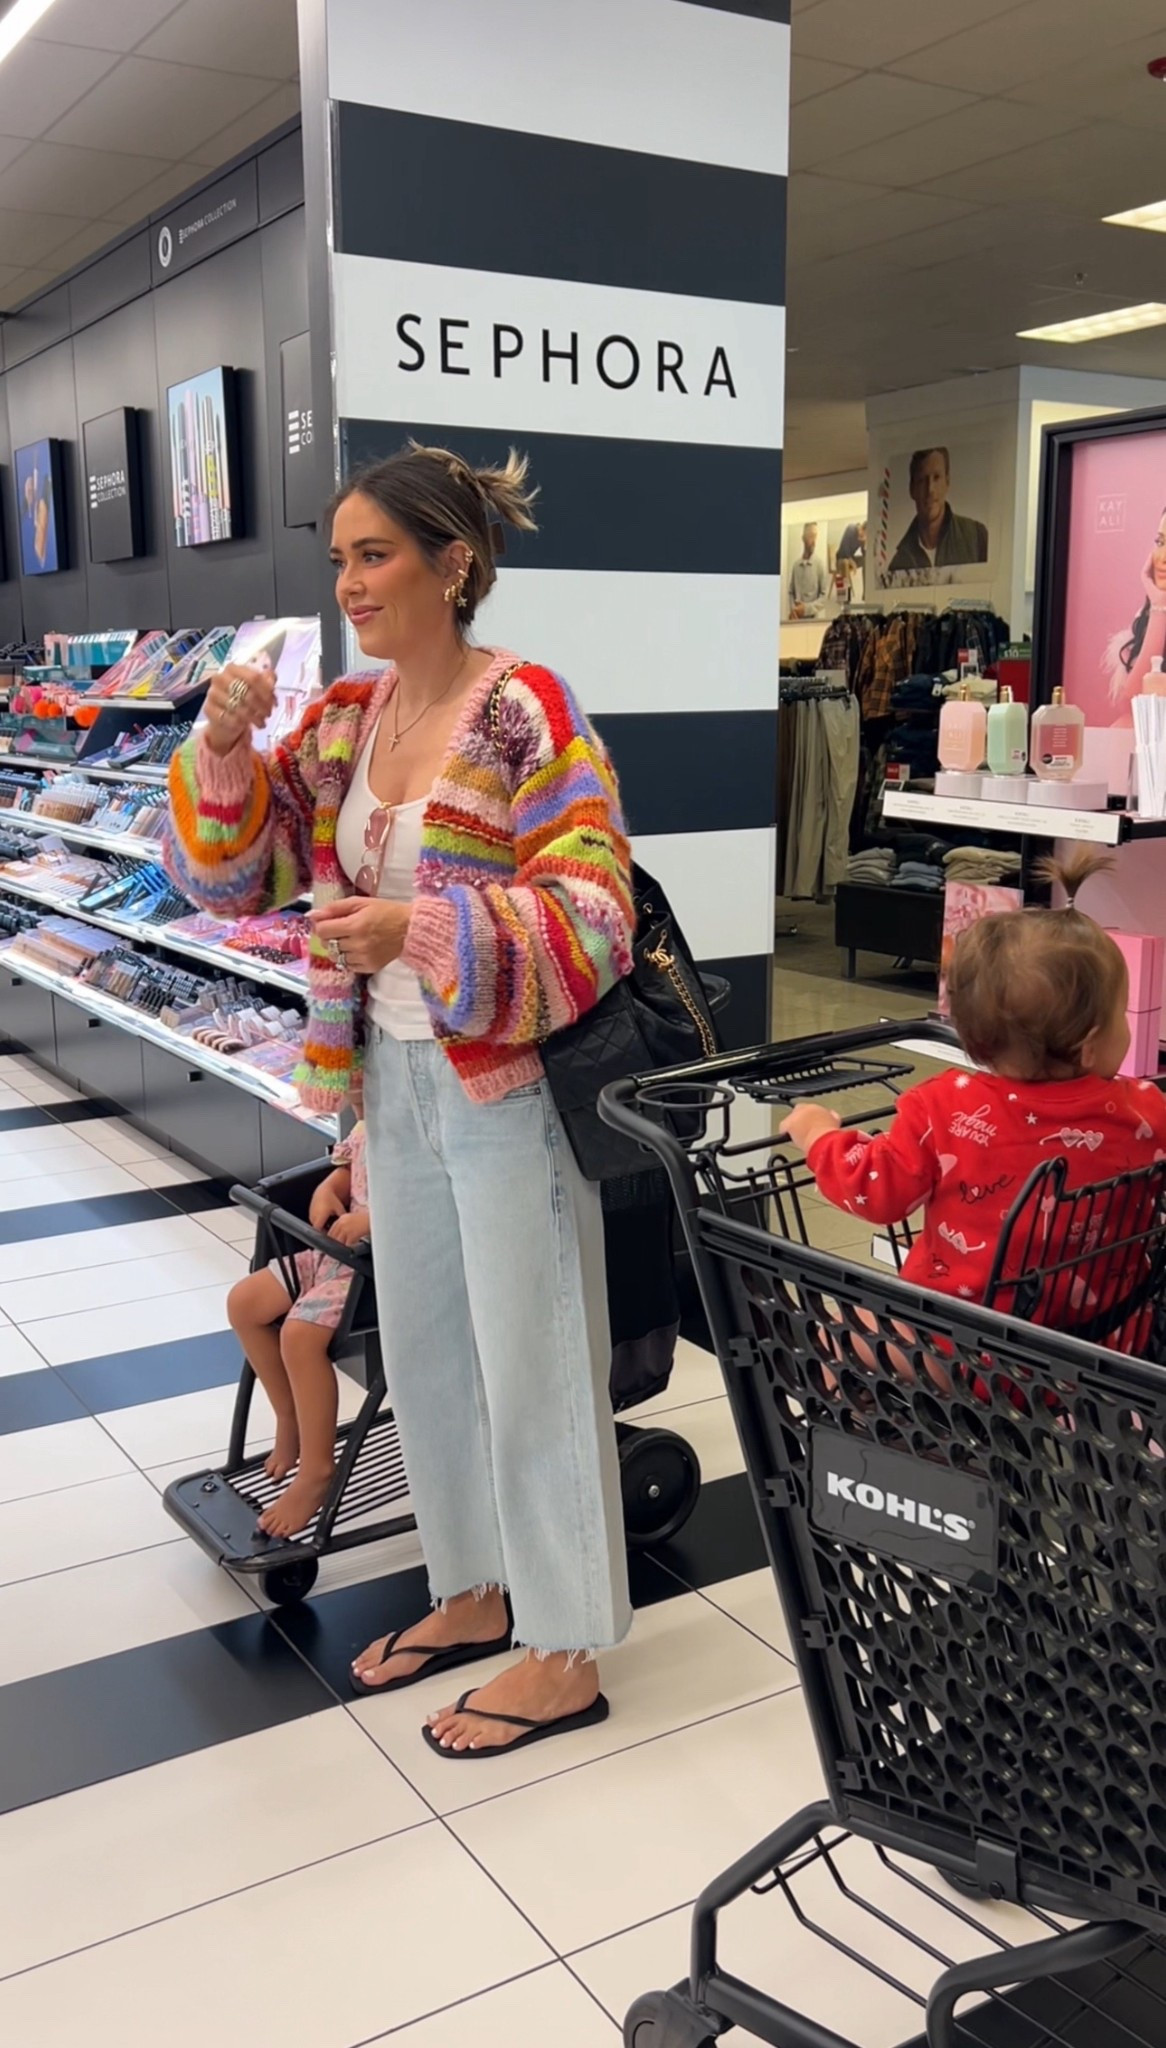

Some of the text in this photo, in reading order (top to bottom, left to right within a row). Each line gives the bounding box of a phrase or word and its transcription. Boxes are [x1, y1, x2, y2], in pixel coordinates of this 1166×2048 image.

[396, 313, 738, 399] SEPHORA
[96, 470, 125, 491] SEPHORA
[97, 486, 126, 503] COLLECTION
[1100, 500, 1122, 512] KAY
[1099, 515, 1120, 528] ALI
[948, 1121, 989, 1147] YOU ARE
[960, 1174, 1017, 1204] love
